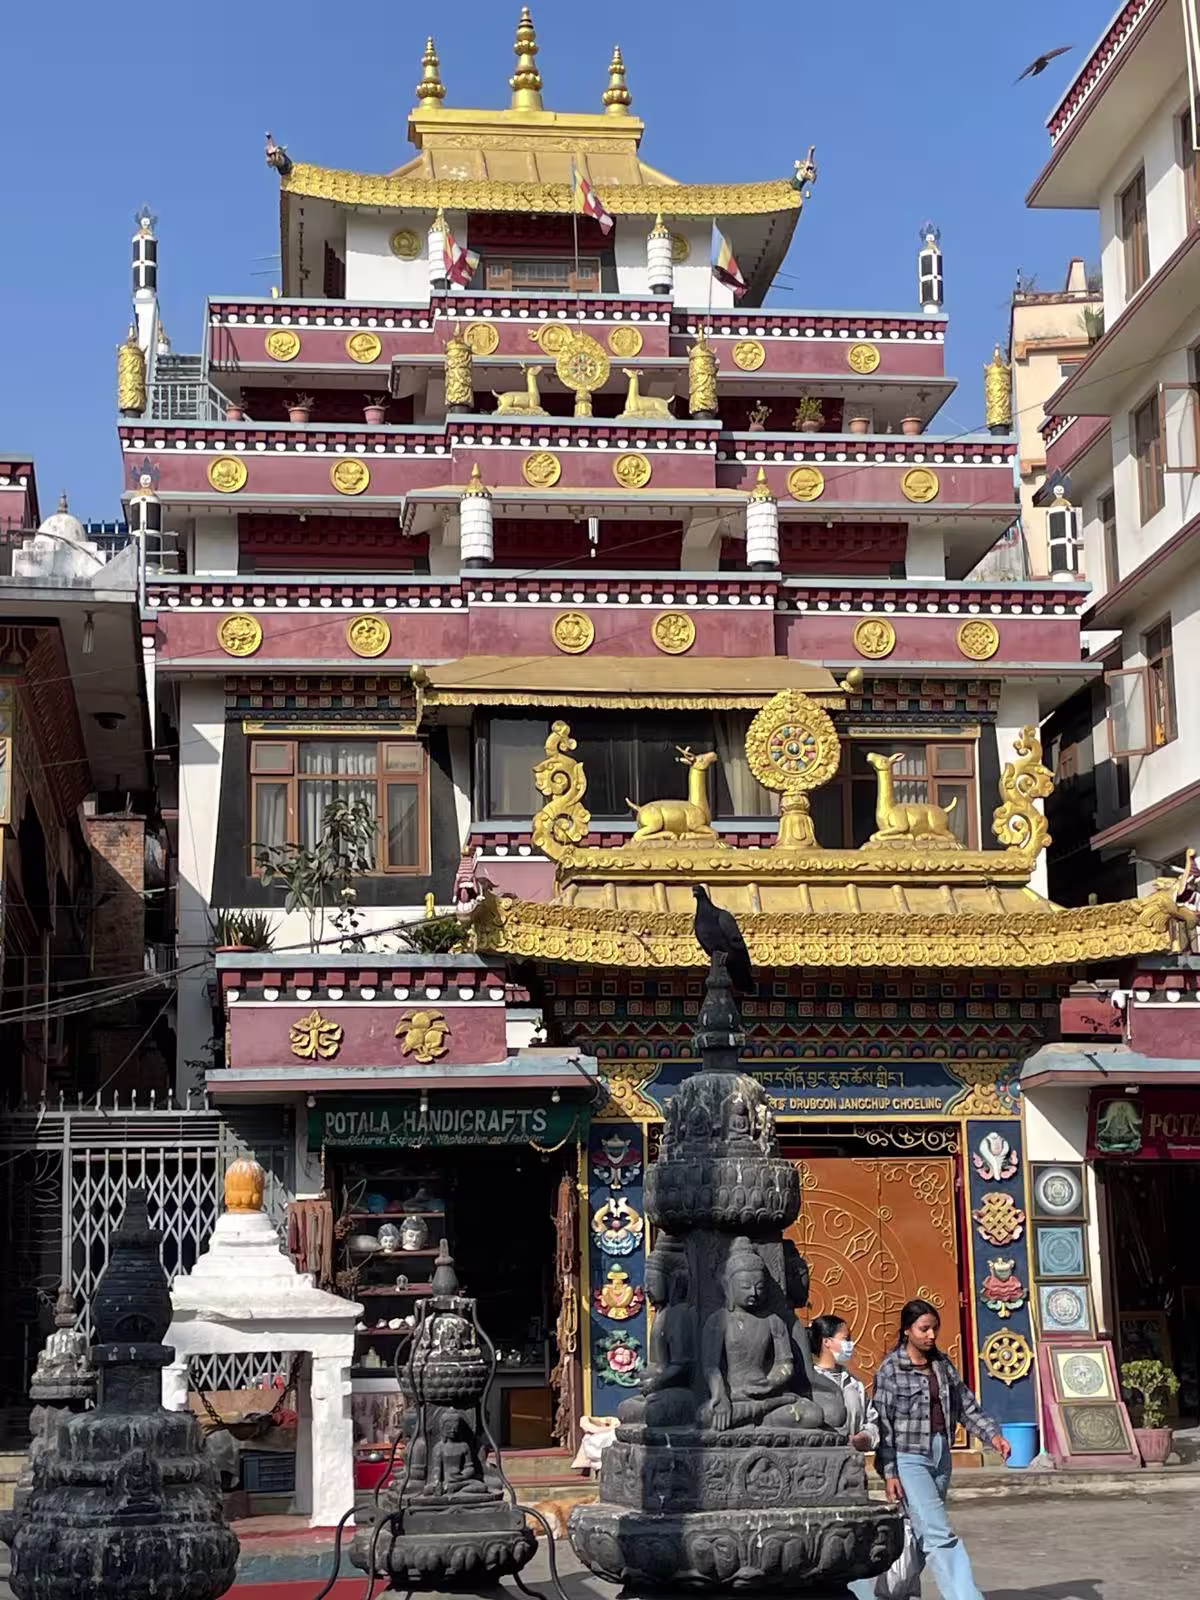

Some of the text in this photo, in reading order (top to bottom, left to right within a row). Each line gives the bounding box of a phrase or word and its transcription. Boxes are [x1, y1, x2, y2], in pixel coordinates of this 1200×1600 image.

[789, 1097, 942, 1110] DRUBGON JANGCHUP CHOELING
[325, 1108, 547, 1134] POTALA HANDICRAFTS
